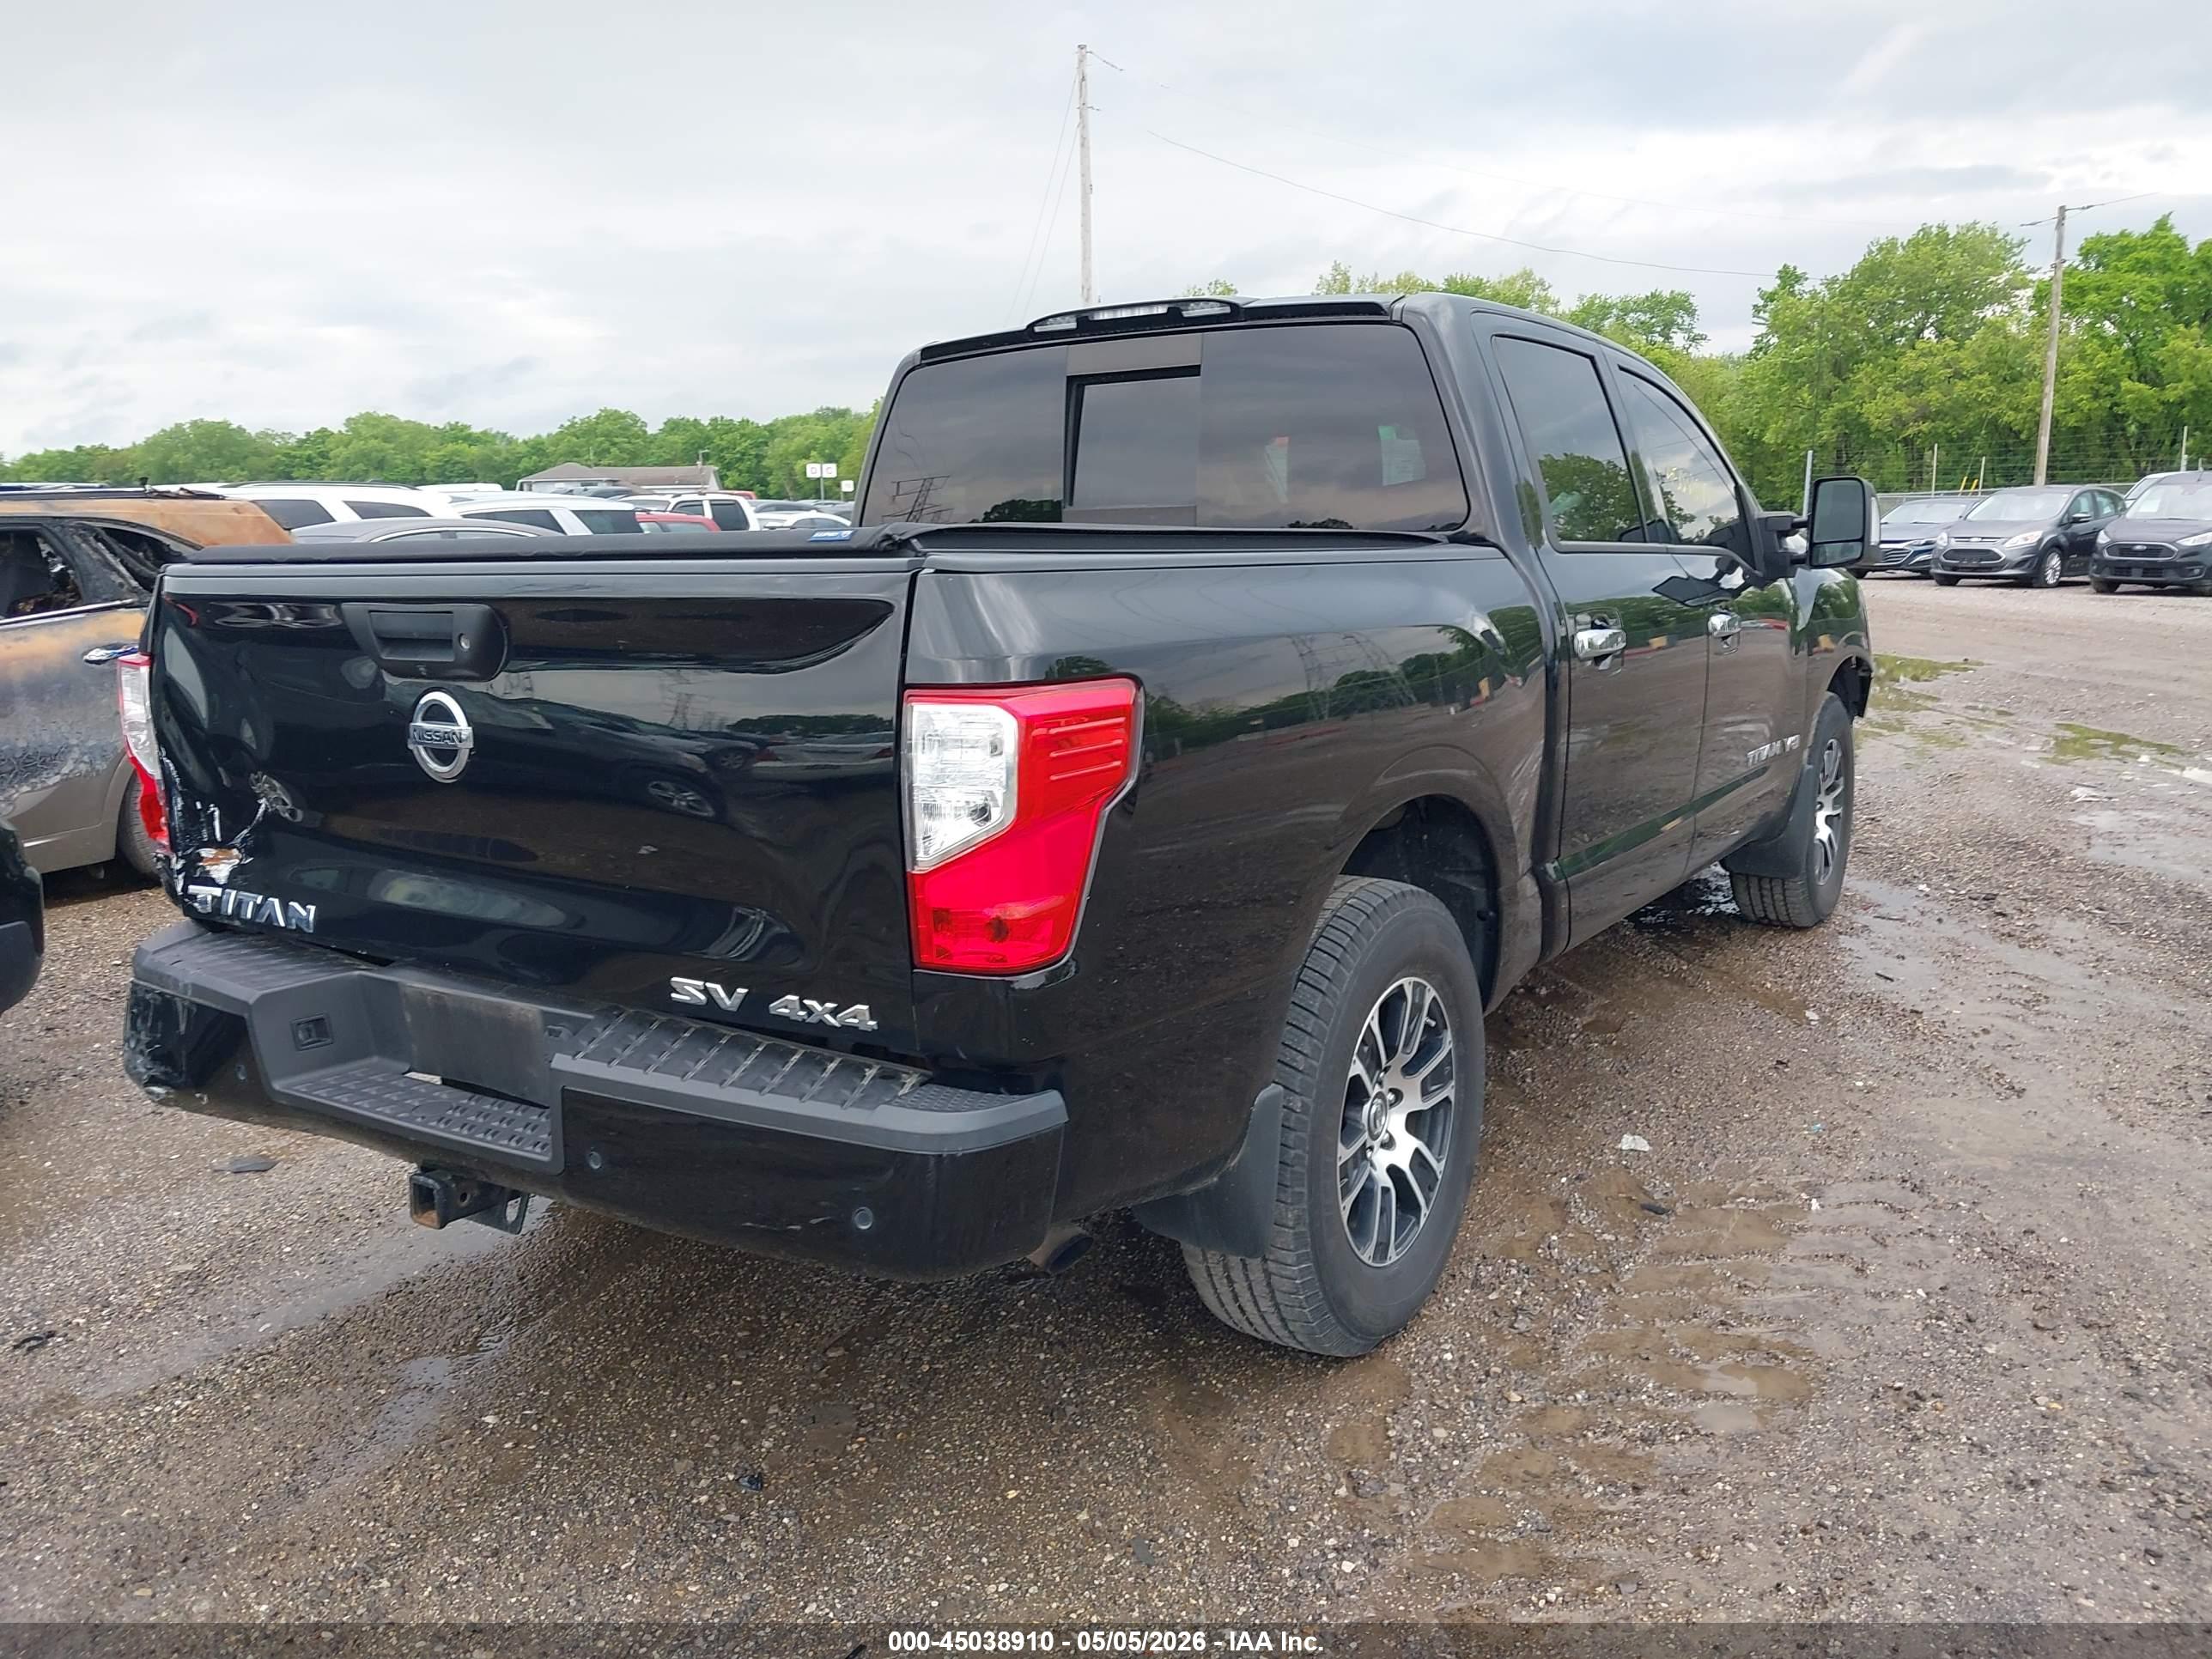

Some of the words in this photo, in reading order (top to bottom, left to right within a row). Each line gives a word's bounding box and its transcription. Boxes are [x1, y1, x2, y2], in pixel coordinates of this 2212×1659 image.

[413, 728, 462, 745] NISSAN
[187, 884, 316, 933] TITAN
[670, 976, 749, 1012] SV
